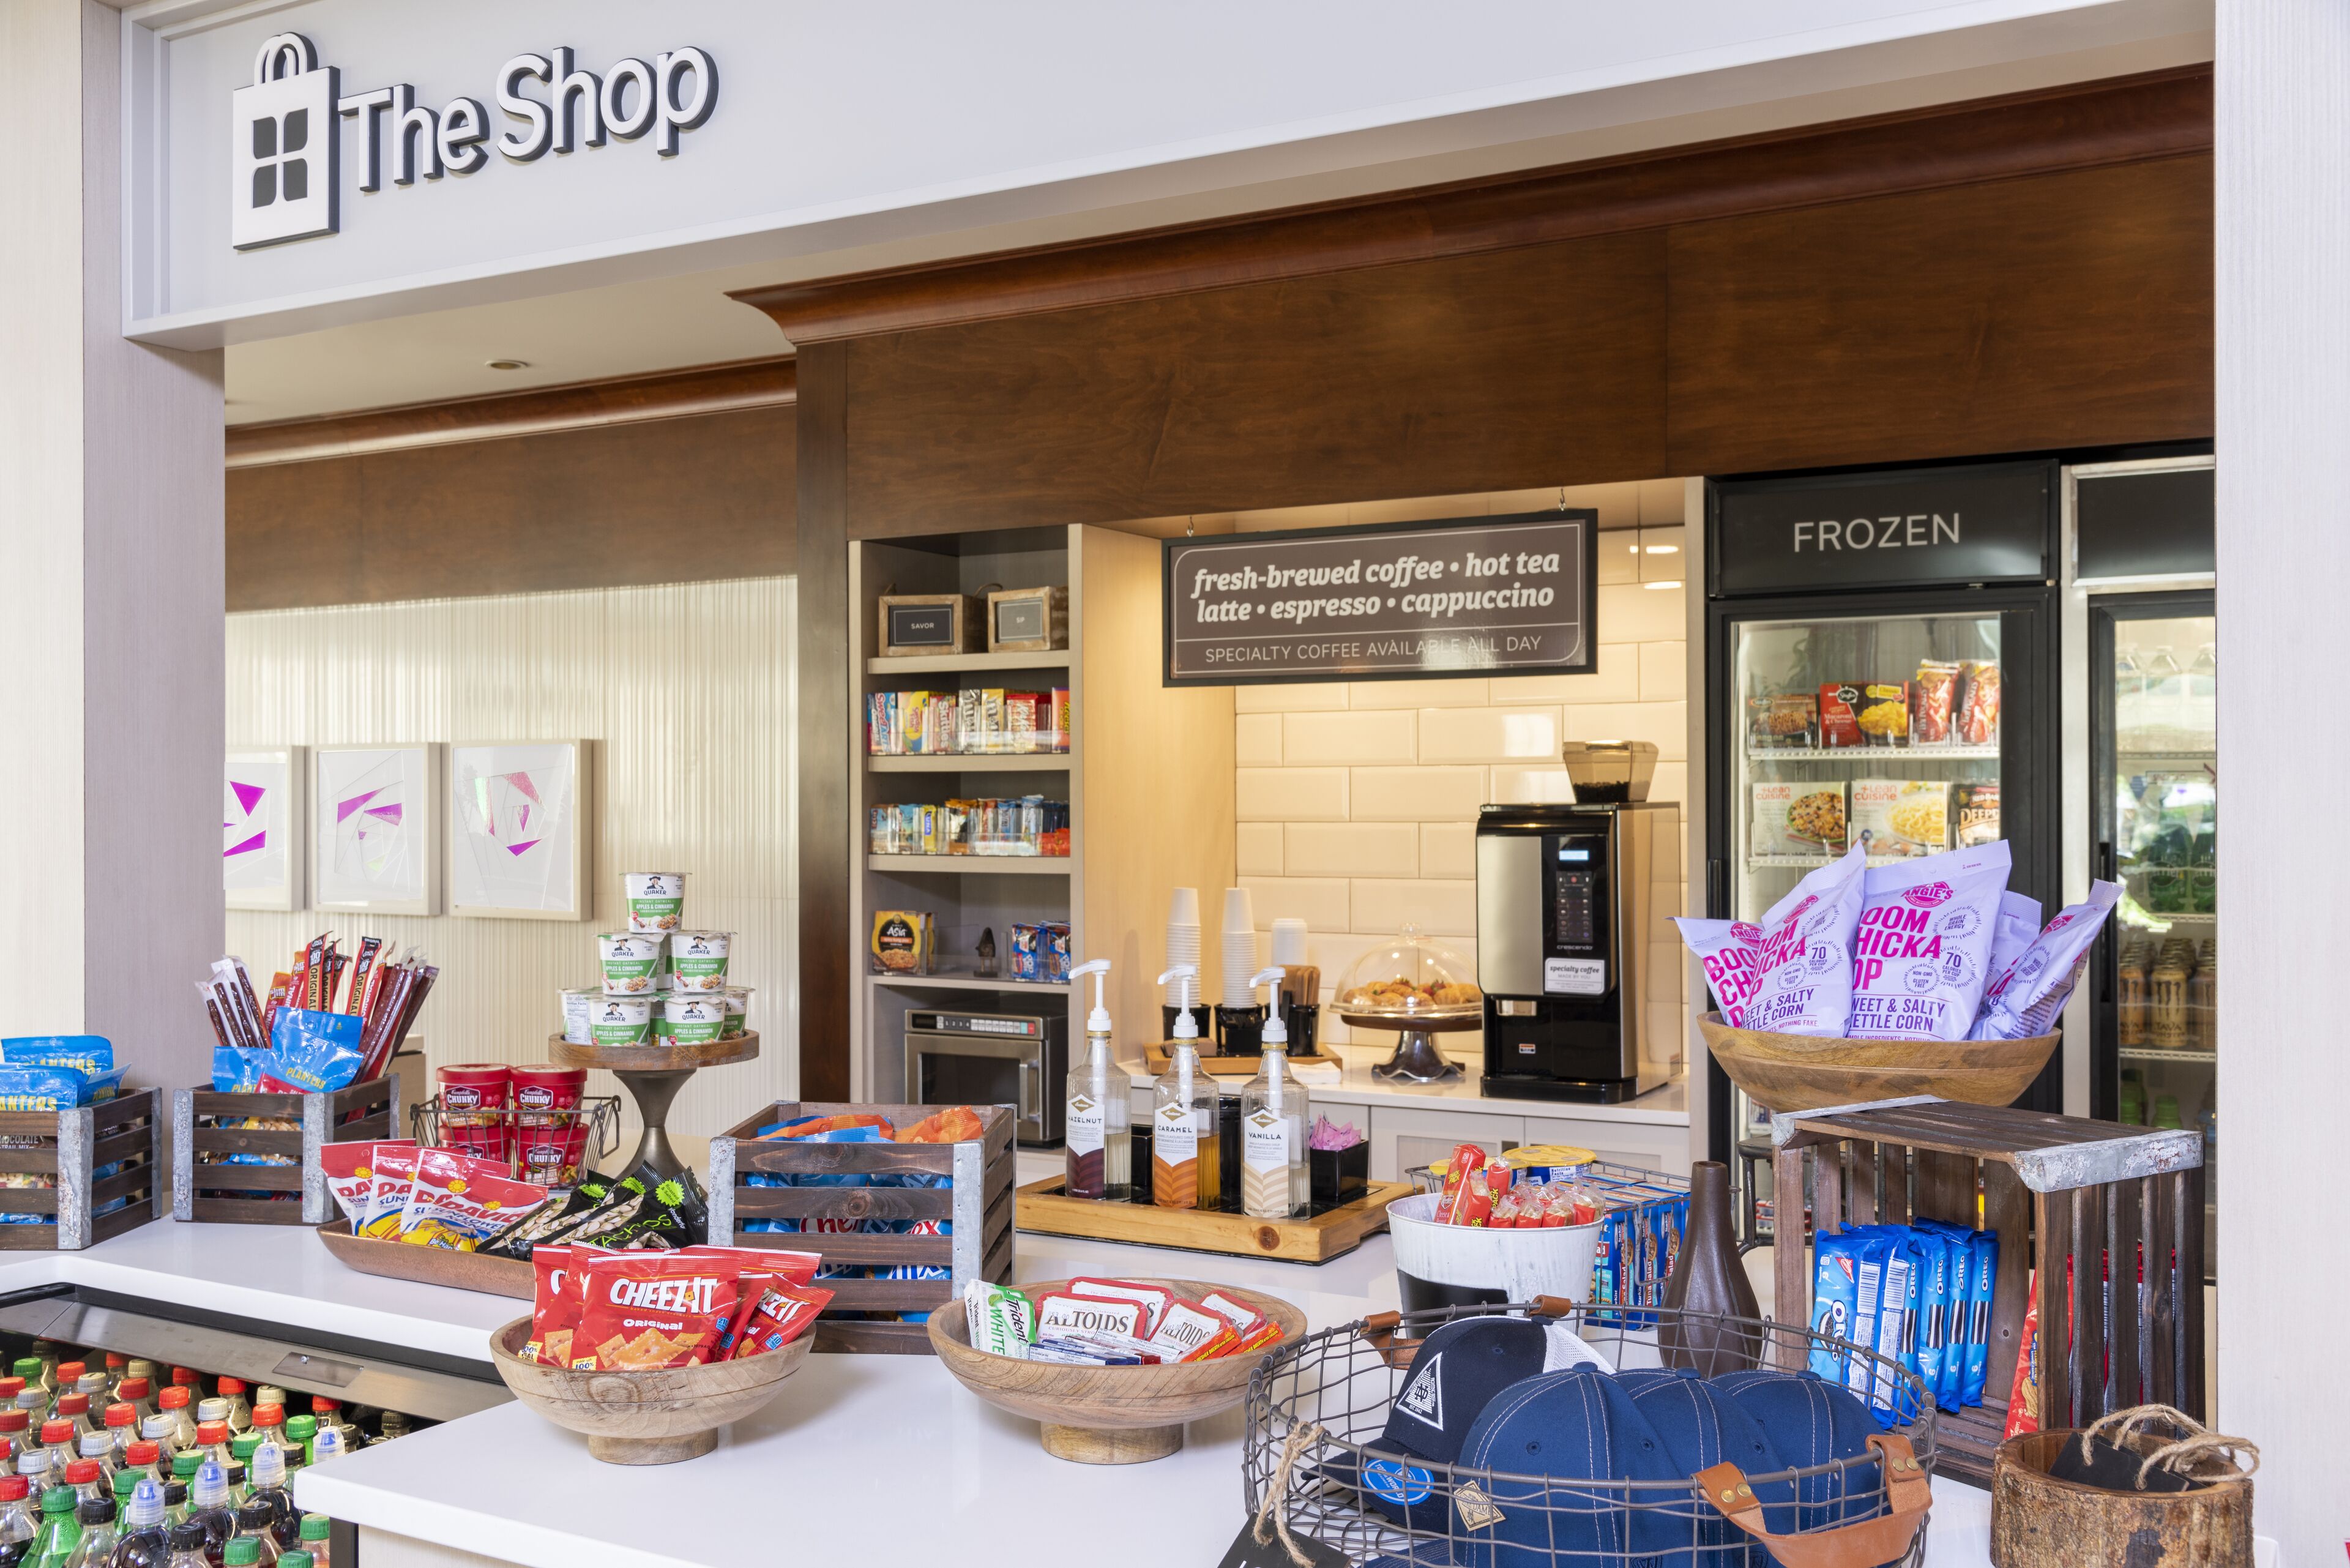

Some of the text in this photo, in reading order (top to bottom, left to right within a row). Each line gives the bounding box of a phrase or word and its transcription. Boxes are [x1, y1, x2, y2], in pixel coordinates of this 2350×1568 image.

[337, 47, 718, 193] The Shop
[1793, 512, 1961, 553] FROZEN
[1190, 550, 1560, 599] fresh-brewed coffee hot tea
[1196, 583, 1554, 624] latte espresso cappuccino
[1205, 635, 1542, 663] SPECIALTY COFFEE AVAILABLE ALL DAY
[1901, 887, 1954, 900] ANGIE'S
[1860, 906, 1931, 934] OOM
[1811, 947, 1826, 959] 70
[1856, 928, 1941, 959] HICKA
[1550, 965, 1599, 975] specialty coffee
[1945, 952, 1961, 968] 70
[309, 968, 318, 1010] ORIGINAL
[350, 976, 364, 1014] ORIGINAL
[1764, 1000, 1772, 1012] &
[1777, 988, 1815, 1006] SALTY
[1852, 998, 1945, 1018] WEET & SALTY
[1772, 1004, 1804, 1021] CORN
[1778, 1020, 1801, 1029] NOTHING
[1897, 1015, 1933, 1032] CORN
[286, 1067, 326, 1089] PLANTERS
[0, 1094, 58, 1111] ANTERS
[447, 1095, 478, 1104] CHUNKY
[520, 1094, 550, 1105] CHUNKY
[664, 1190, 676, 1204] Salted
[665, 1184, 679, 1200] Roasted
[441, 1200, 520, 1222] DAVID
[718, 1318, 729, 1326] 210
[990, 1309, 1005, 1355] WHITE
[1005, 1299, 1029, 1344] Trident
[1045, 1311, 1129, 1333] ALTOIDS
[1253, 1340, 1264, 1350] BREATH
